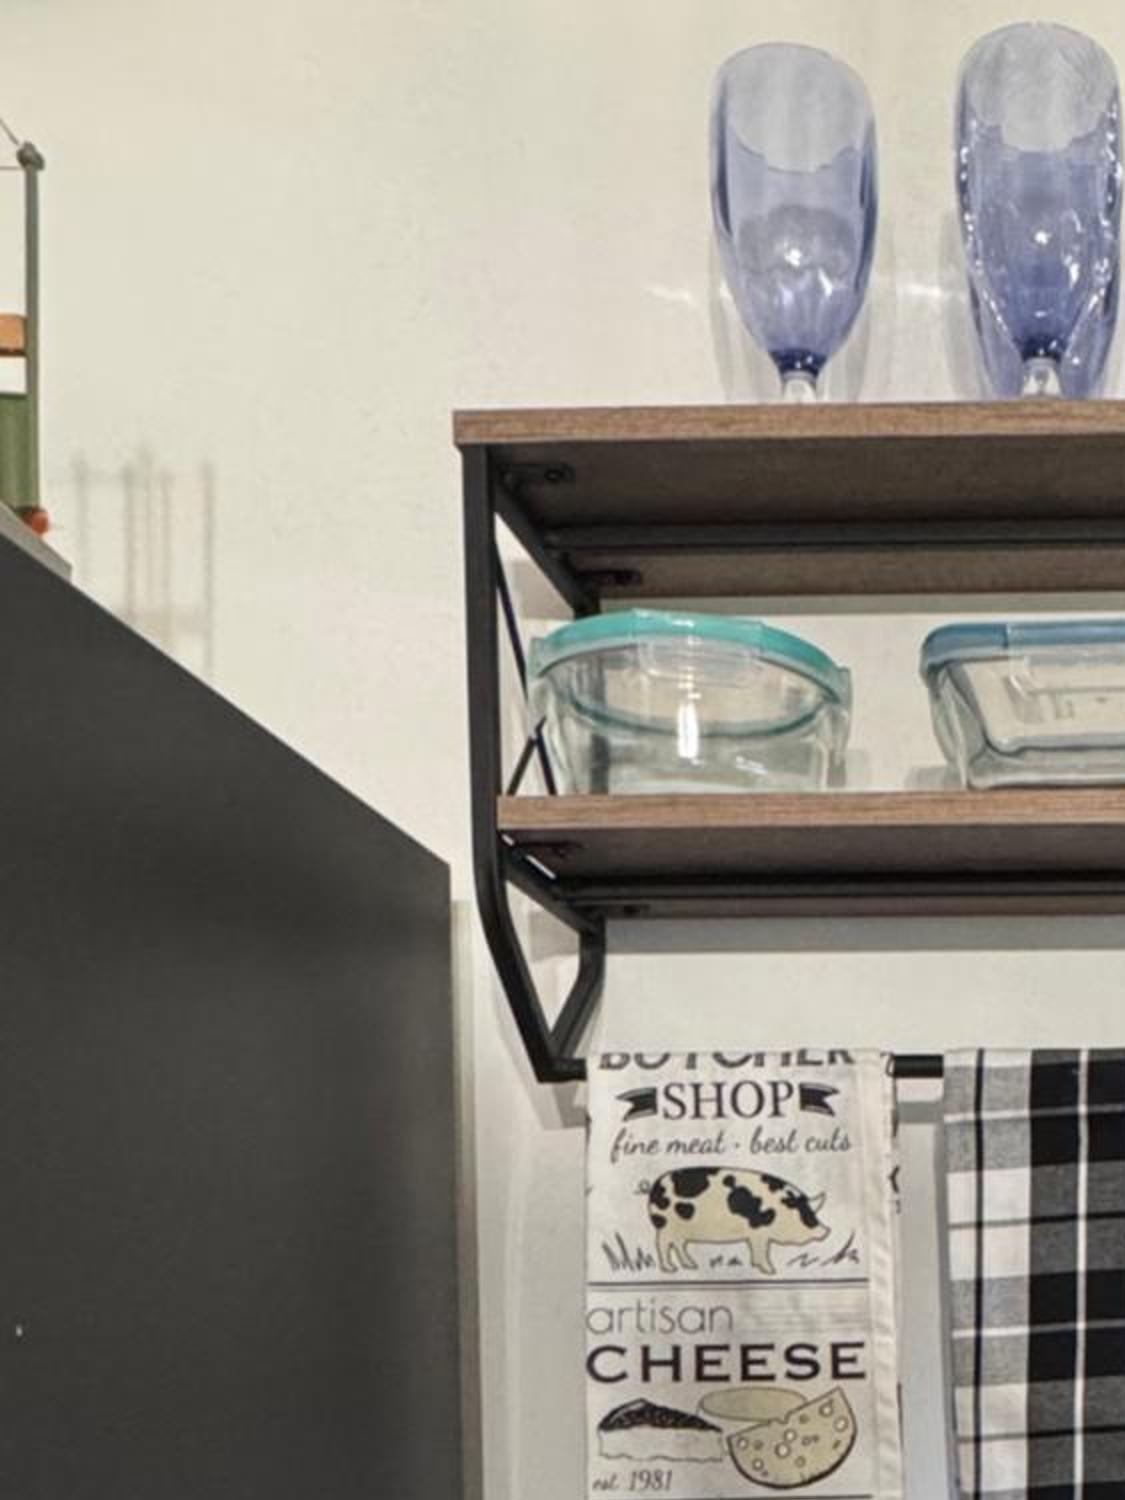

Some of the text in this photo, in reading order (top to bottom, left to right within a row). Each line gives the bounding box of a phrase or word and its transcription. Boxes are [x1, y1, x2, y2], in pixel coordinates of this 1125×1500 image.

[662, 1080, 794, 1119] SHOP
[610, 1125, 850, 1164] fine meat best cuts
[586, 1299, 734, 1335] artisan
[586, 1341, 867, 1383] CHEESE
[628, 1470, 673, 1491] 1981
